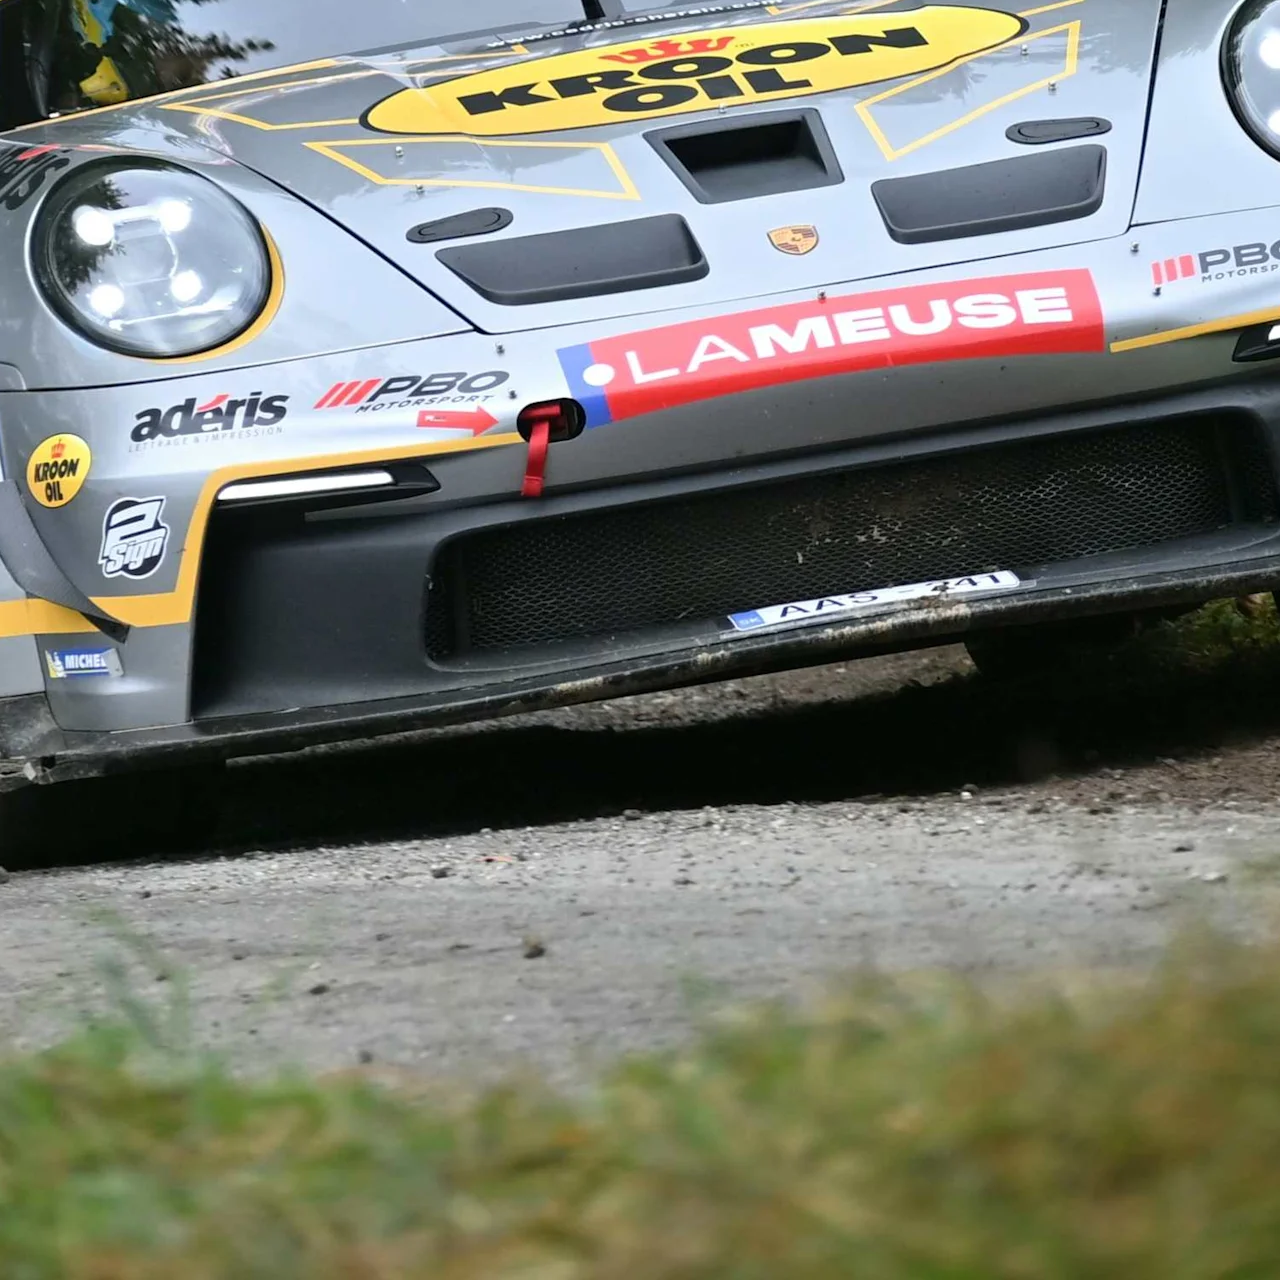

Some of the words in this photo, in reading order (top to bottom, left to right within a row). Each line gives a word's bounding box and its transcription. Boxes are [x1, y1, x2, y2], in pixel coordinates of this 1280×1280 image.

[456, 26, 929, 116] KROON
[602, 68, 813, 113] OIL
[367, 370, 510, 403] PBO
[355, 394, 495, 415] MOTORSPORT
[34, 458, 80, 483] KROON
[45, 480, 64, 503] OIL
[105, 536, 165, 573] Sign
